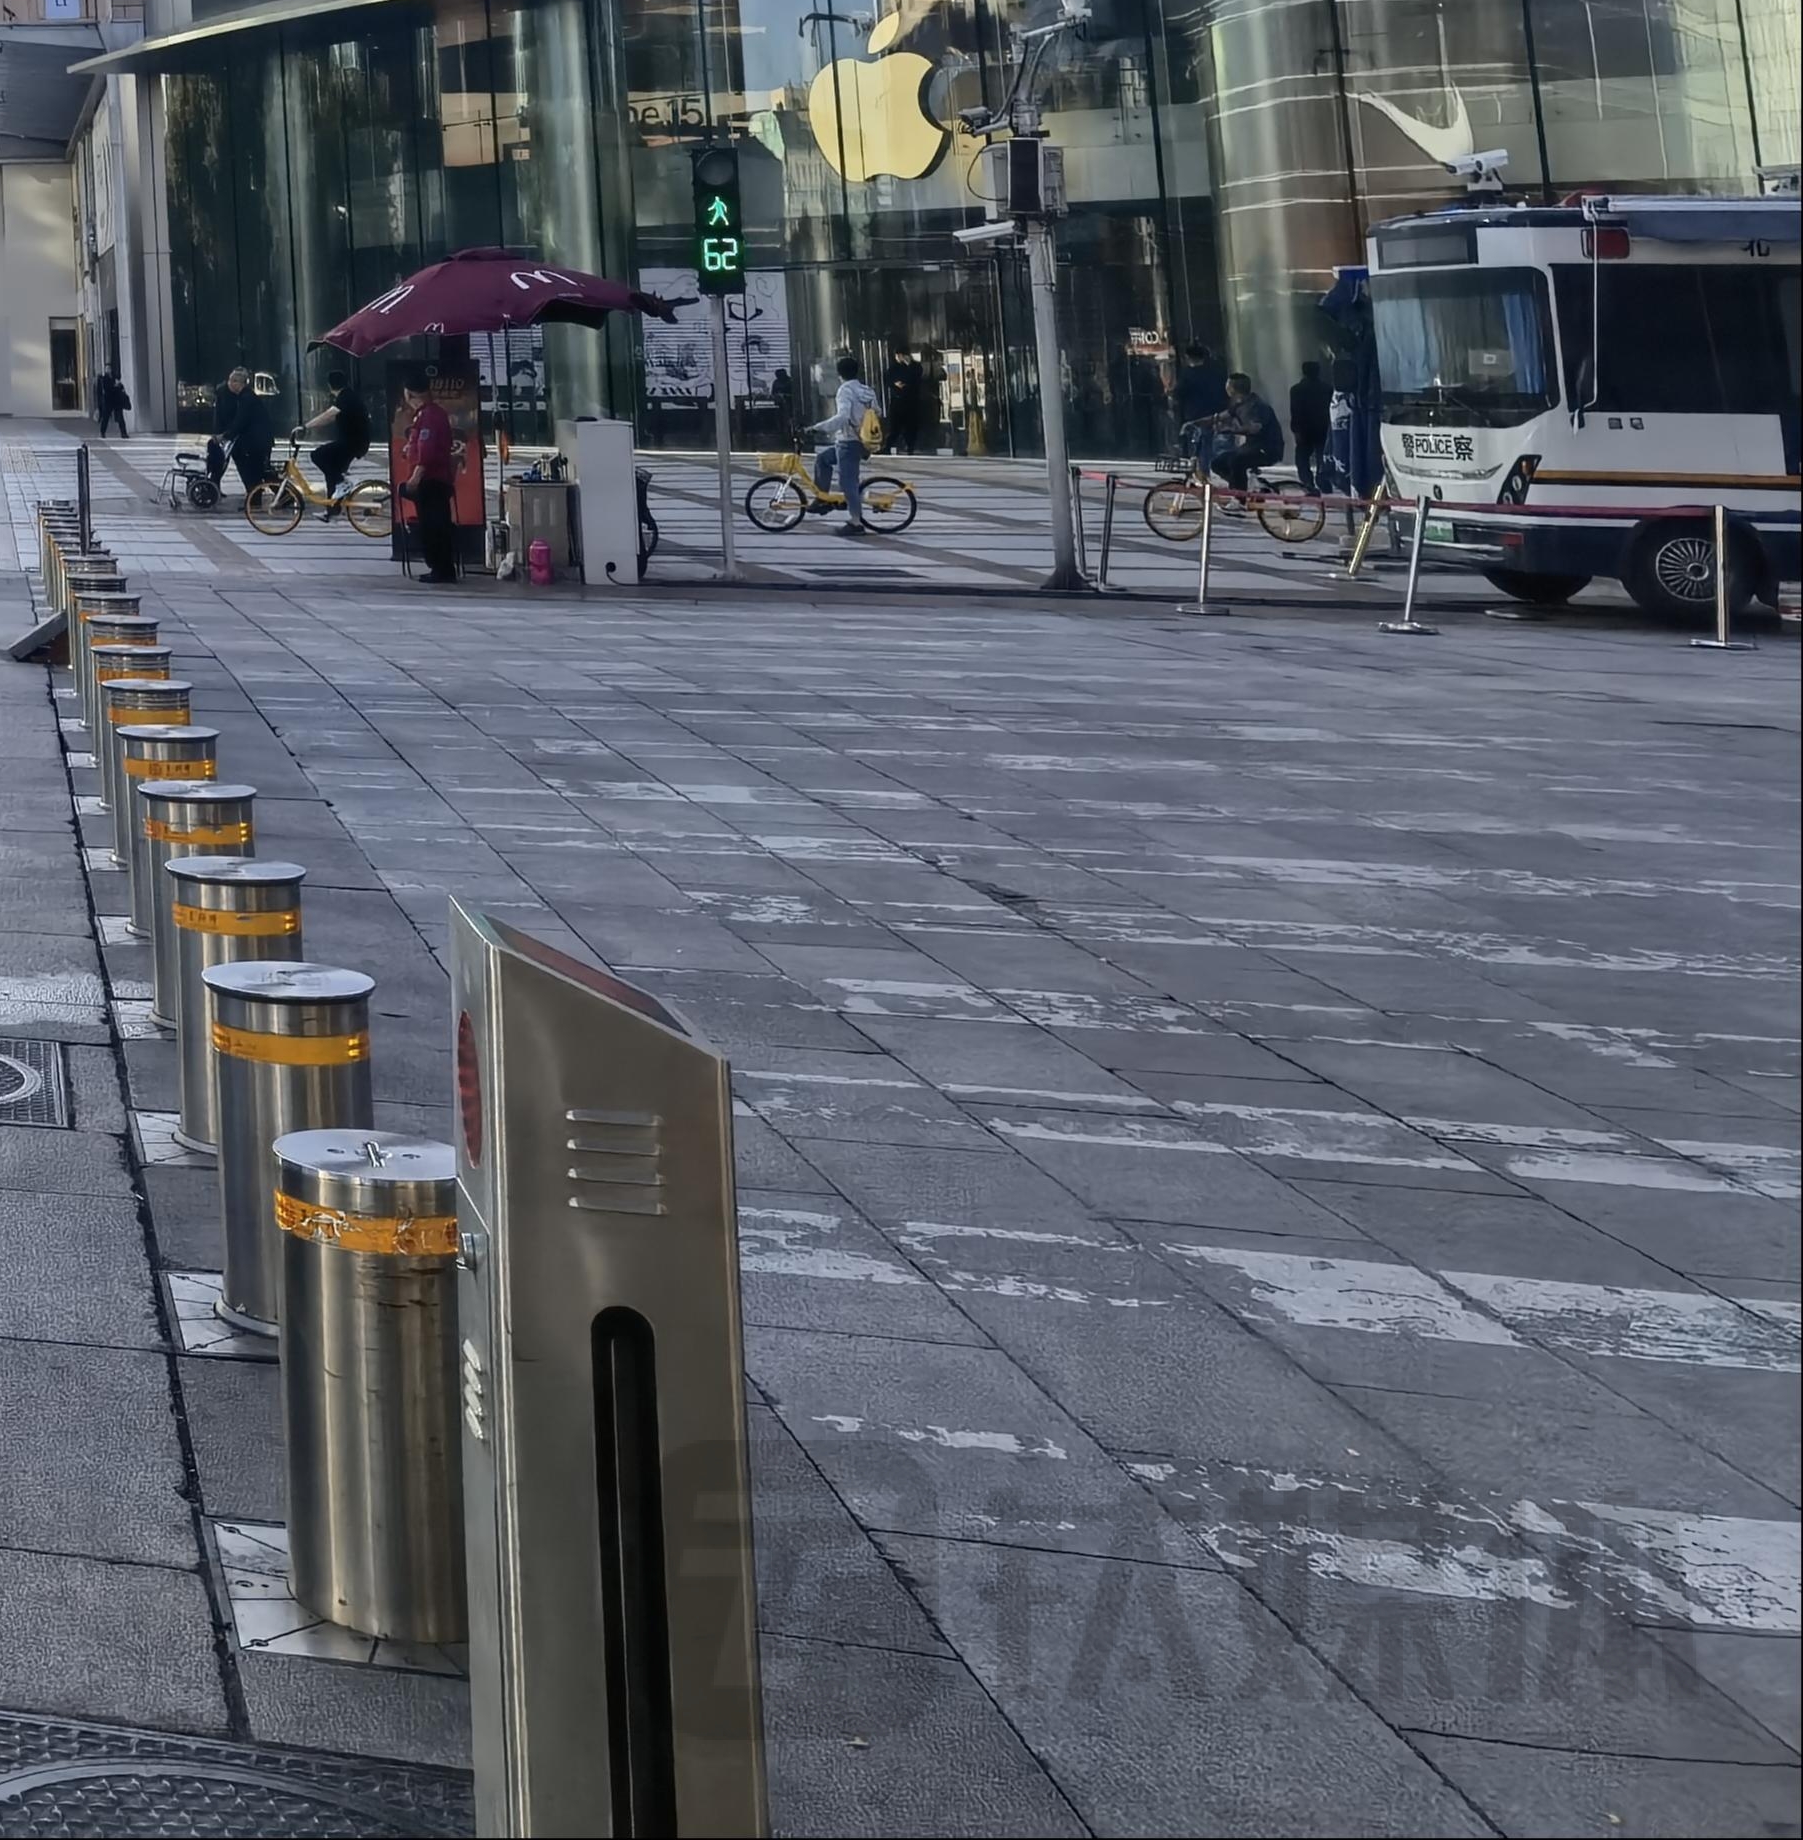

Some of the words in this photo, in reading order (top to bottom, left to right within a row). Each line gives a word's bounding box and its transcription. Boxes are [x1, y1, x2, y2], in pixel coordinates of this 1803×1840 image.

[666, 98, 704, 127] 15
[703, 238, 738, 271] 62
[1415, 437, 1453, 455] POLICE
[1453, 435, 1474, 461] 察
